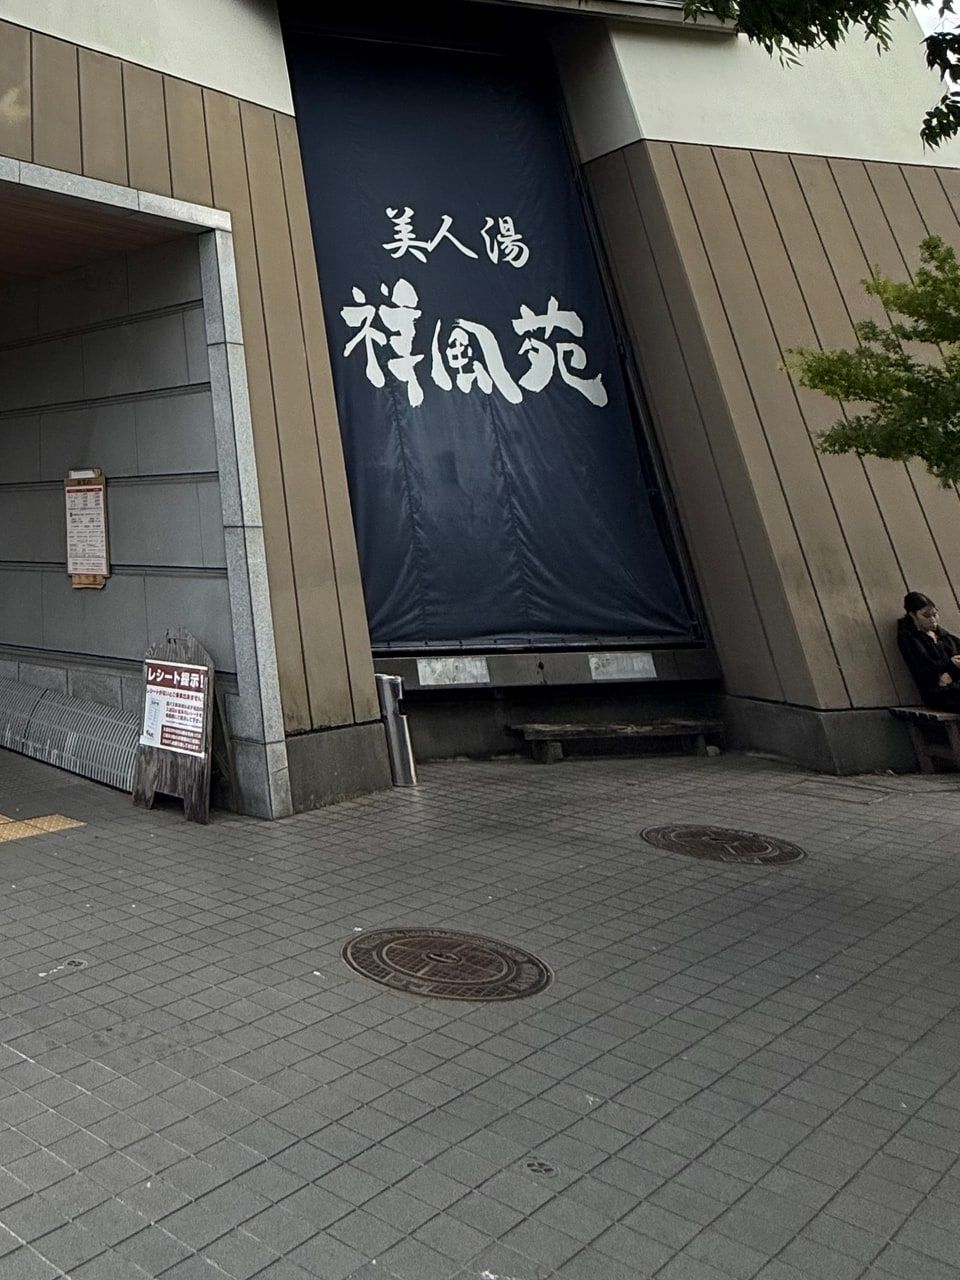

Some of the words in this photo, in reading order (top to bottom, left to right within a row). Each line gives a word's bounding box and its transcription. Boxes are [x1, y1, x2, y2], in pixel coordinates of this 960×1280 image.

[382, 207, 530, 268] 美人湯
[340, 278, 608, 408] 祥風苑
